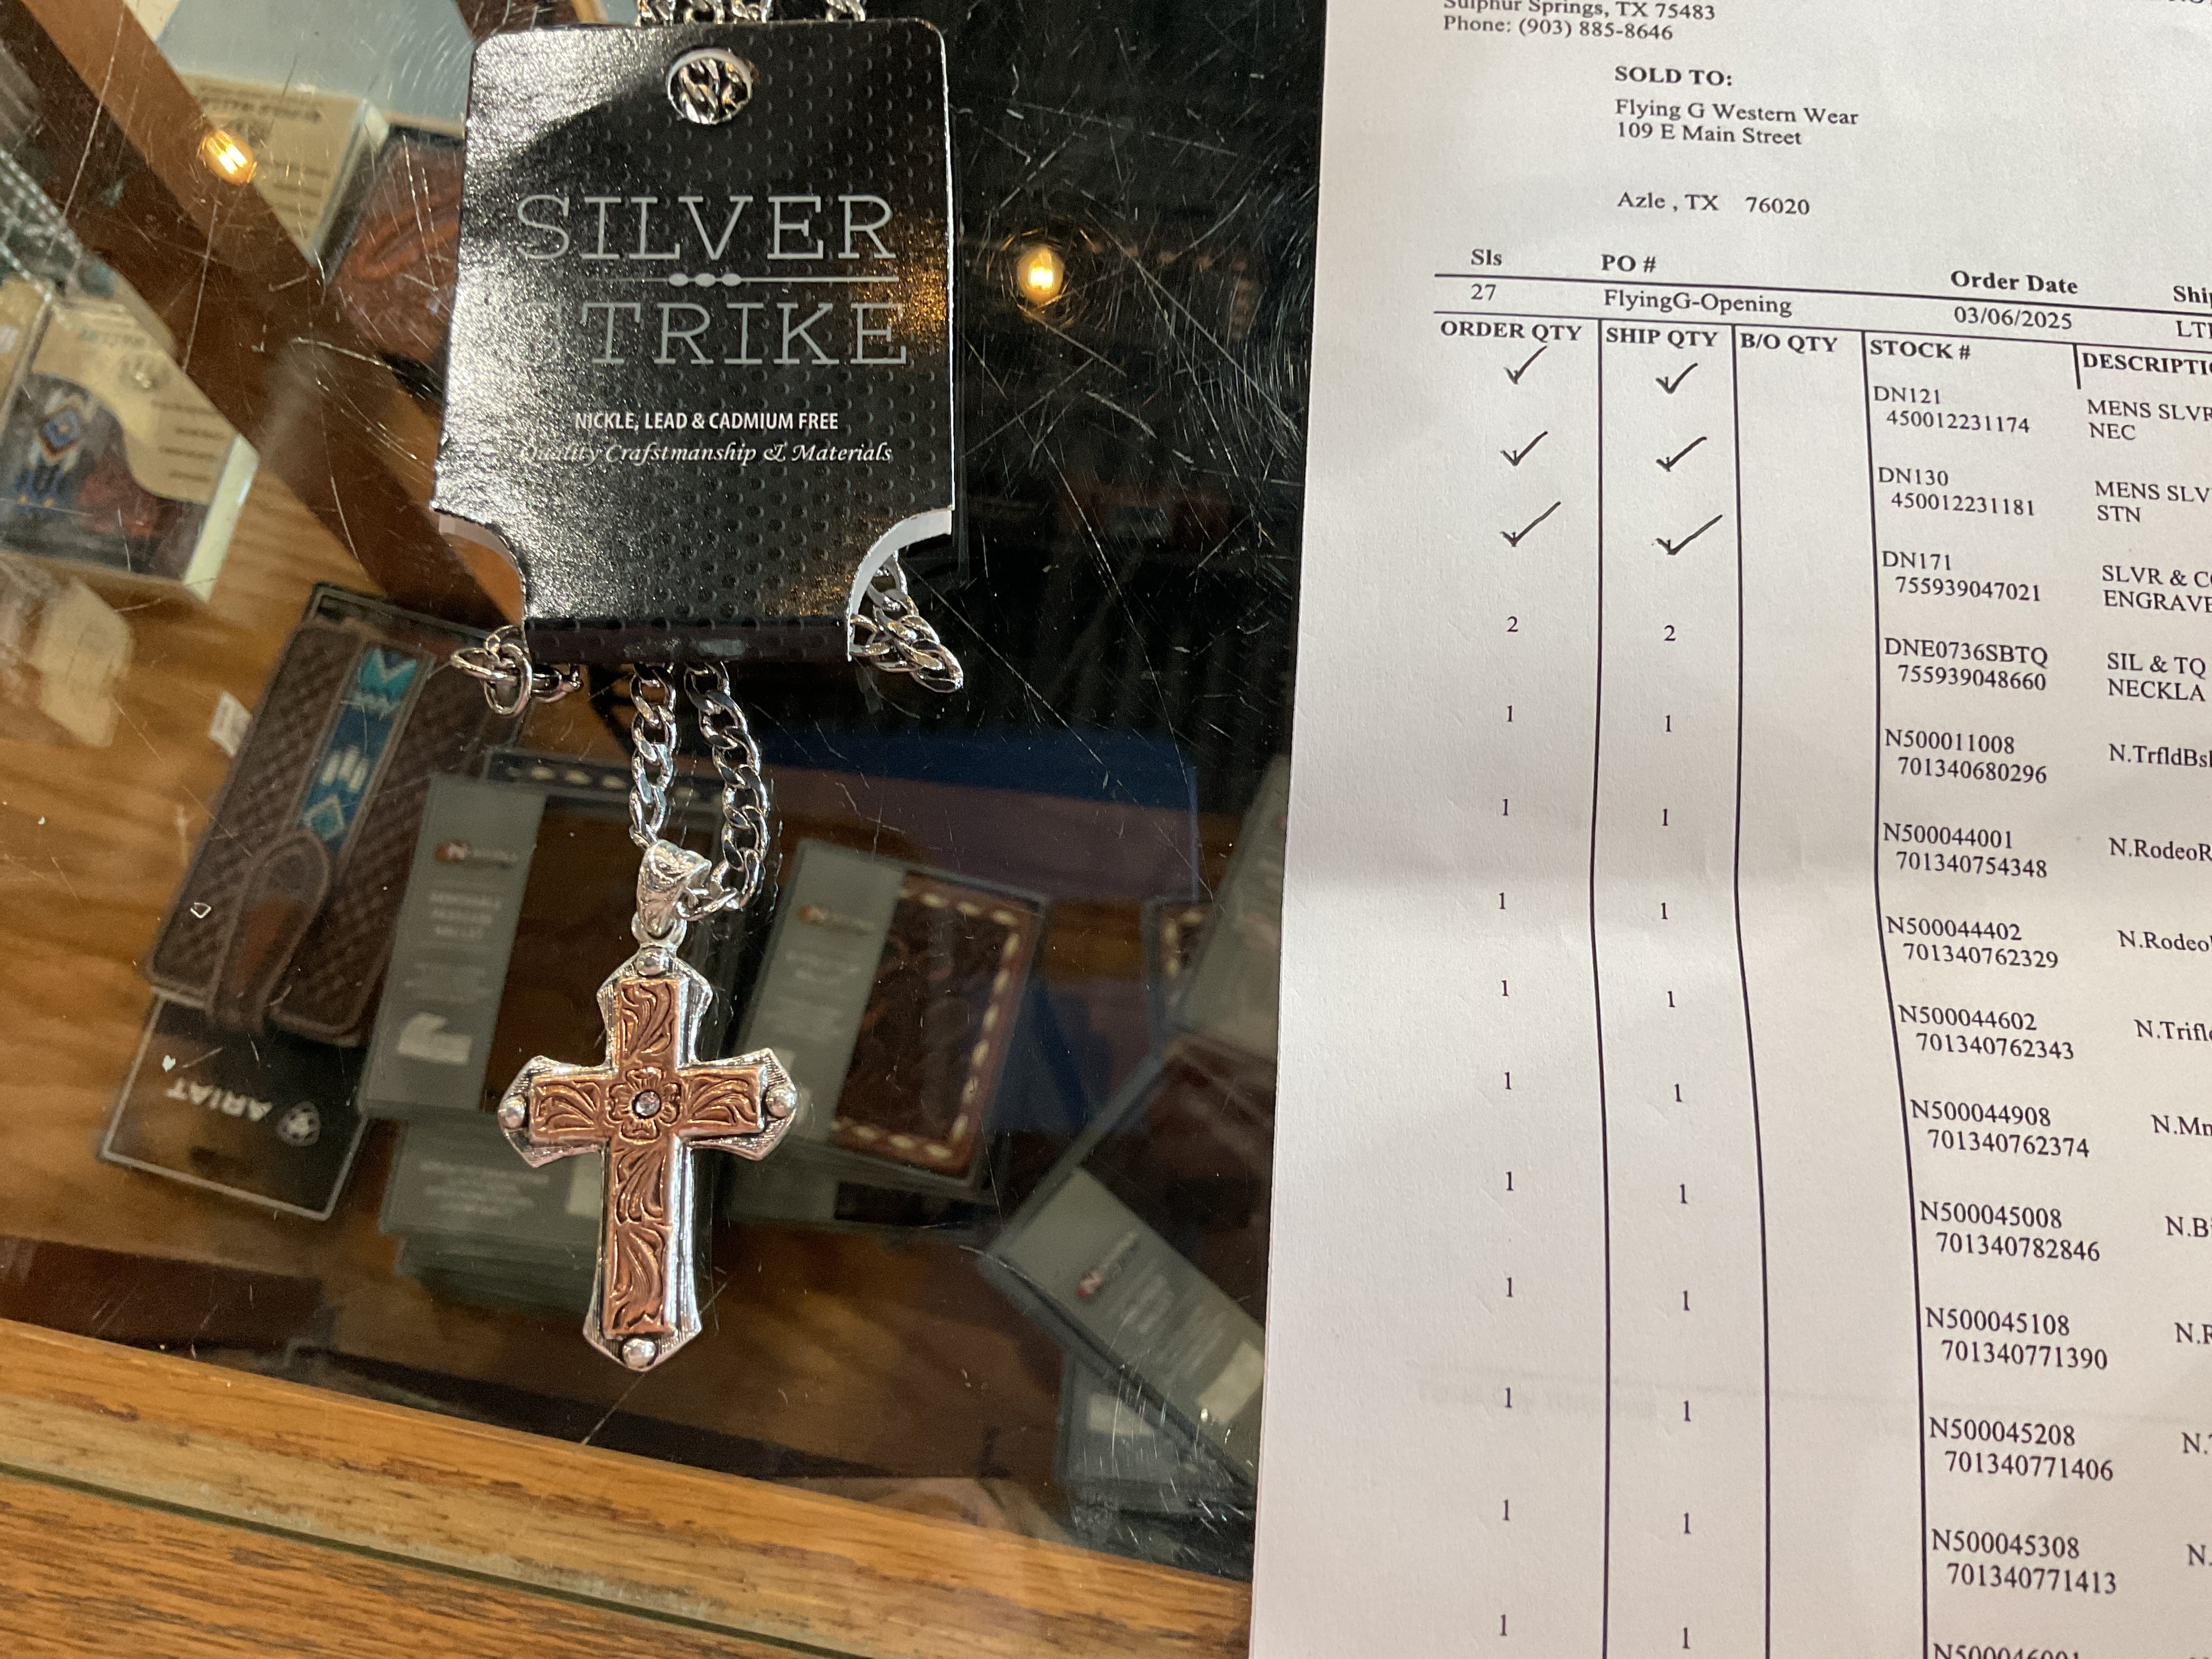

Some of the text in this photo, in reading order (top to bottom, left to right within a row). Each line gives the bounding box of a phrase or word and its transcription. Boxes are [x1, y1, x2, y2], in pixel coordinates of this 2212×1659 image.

[1528, 0, 1609, 18] Springs,
[1615, 1, 1649, 18] TX
[1654, 2, 1715, 21] 75483
[1444, 14, 1673, 40] Phone: (903) 885-8646
[1615, 65, 1732, 87] SOLD TO:
[1615, 98, 1859, 125] Flying G Western Wear
[1618, 121, 1802, 145] 109 E Main Street
[1684, 194, 1719, 211] TX
[1744, 196, 1810, 215] 76020
[516, 194, 896, 260] SILVER
[1471, 248, 1502, 266] Sls
[1601, 253, 1656, 274] PO #
[1471, 283, 1497, 301] 27
[1950, 270, 2078, 295] Order Date
[1604, 289, 1793, 319] FlyingG-Opening
[2173, 285, 2212, 309] Shi
[1954, 306, 2073, 330] 03/06/2025
[517, 301, 907, 365] TRIKE
[1440, 320, 1582, 343] ORDER QTY
[1605, 327, 1719, 350] SHIP QTY
[1740, 332, 1838, 355] B/O QTY
[1870, 339, 1971, 361] STOCK #
[2081, 352, 2212, 376] DESCRIPTI
[1873, 385, 1940, 405] DN121
[575, 412, 838, 431] NICKLE, LEAD & CADMIUM FREE
[1886, 410, 2030, 434] 450012231174
[2086, 399, 2212, 422] MENS SLVR
[2088, 422, 2136, 441] NEC
[605, 441, 756, 467] Crafstmanship
[763, 442, 787, 461] &
[791, 441, 892, 462] Materials
[1878, 466, 1949, 487] DN130
[2094, 480, 2210, 503] MENS SLV
[1891, 491, 2035, 516] 450012231181
[2097, 504, 2141, 524] STN
[1881, 550, 1951, 571] DN171
[2102, 565, 2212, 588] SLVR & C
[1895, 575, 2040, 602] 755939047021
[2103, 589, 2212, 613] ENGRAVE
[1506, 615, 1519, 632] 2
[1664, 624, 1676, 642] 2
[1884, 637, 2048, 670] DNE0736SBTQ
[1897, 664, 2047, 691] 755939048660
[2107, 652, 2206, 680] SIL & TQ
[2107, 677, 2206, 702] NECKLA
[1506, 705, 1513, 723] 1
[1665, 714, 1672, 733] 1
[1884, 728, 2015, 755] N500011008
[2108, 743, 2212, 768] N.TrfldBs
[1897, 756, 2047, 784] 701340680296
[1502, 798, 1509, 817] 1
[1662, 808, 1669, 827] 1
[1883, 822, 2013, 849] N500044001
[2108, 836, 2212, 862] N.RodeoR
[1896, 851, 2047, 878] 701340754348
[1498, 892, 1506, 910] 1
[1660, 902, 1669, 920] 1
[1885, 915, 2022, 941] N500044402
[2116, 930, 2212, 952] N.Rodeo
[1903, 942, 2059, 968] 701340762329
[1501, 979, 1509, 997] 1
[1666, 990, 1676, 1008] 1
[1897, 1004, 2037, 1031] N500044602
[1915, 1032, 2074, 1060] 701340762343
[1504, 1071, 1512, 1090] 1
[166, 1077, 274, 1122] ARIAT
[1673, 1083, 1683, 1103] 1
[1909, 1099, 2051, 1127] N500044908
[1927, 1128, 2090, 1158] 701340762374
[1505, 1171, 1514, 1192] 1
[1679, 1183, 1688, 1205] 1
[1919, 1200, 2062, 1229] N500045008
[2164, 1215, 2212, 1238] N.B
[1936, 1232, 2100, 1262] 701340782846
[1506, 1277, 1513, 1298] 1
[1682, 1290, 1690, 1312] 1
[1925, 1306, 2070, 1336] N500045108
[1941, 1339, 2108, 1371] 701340771390
[1505, 1387, 1513, 1409] 1
[1683, 1400, 1691, 1422] 1
[1929, 1416, 2075, 1446] N500045208
[2181, 1431, 2212, 1455] N.
[1944, 1450, 2113, 1482] 701340771406
[1503, 1499, 1510, 1521] 1
[1683, 1512, 1691, 1535] 1
[1931, 1528, 2080, 1559] N500045308
[1946, 1562, 2116, 1595] 701340771413
[1499, 1614, 1508, 1637] 1
[1682, 1626, 1691, 1650] 1
